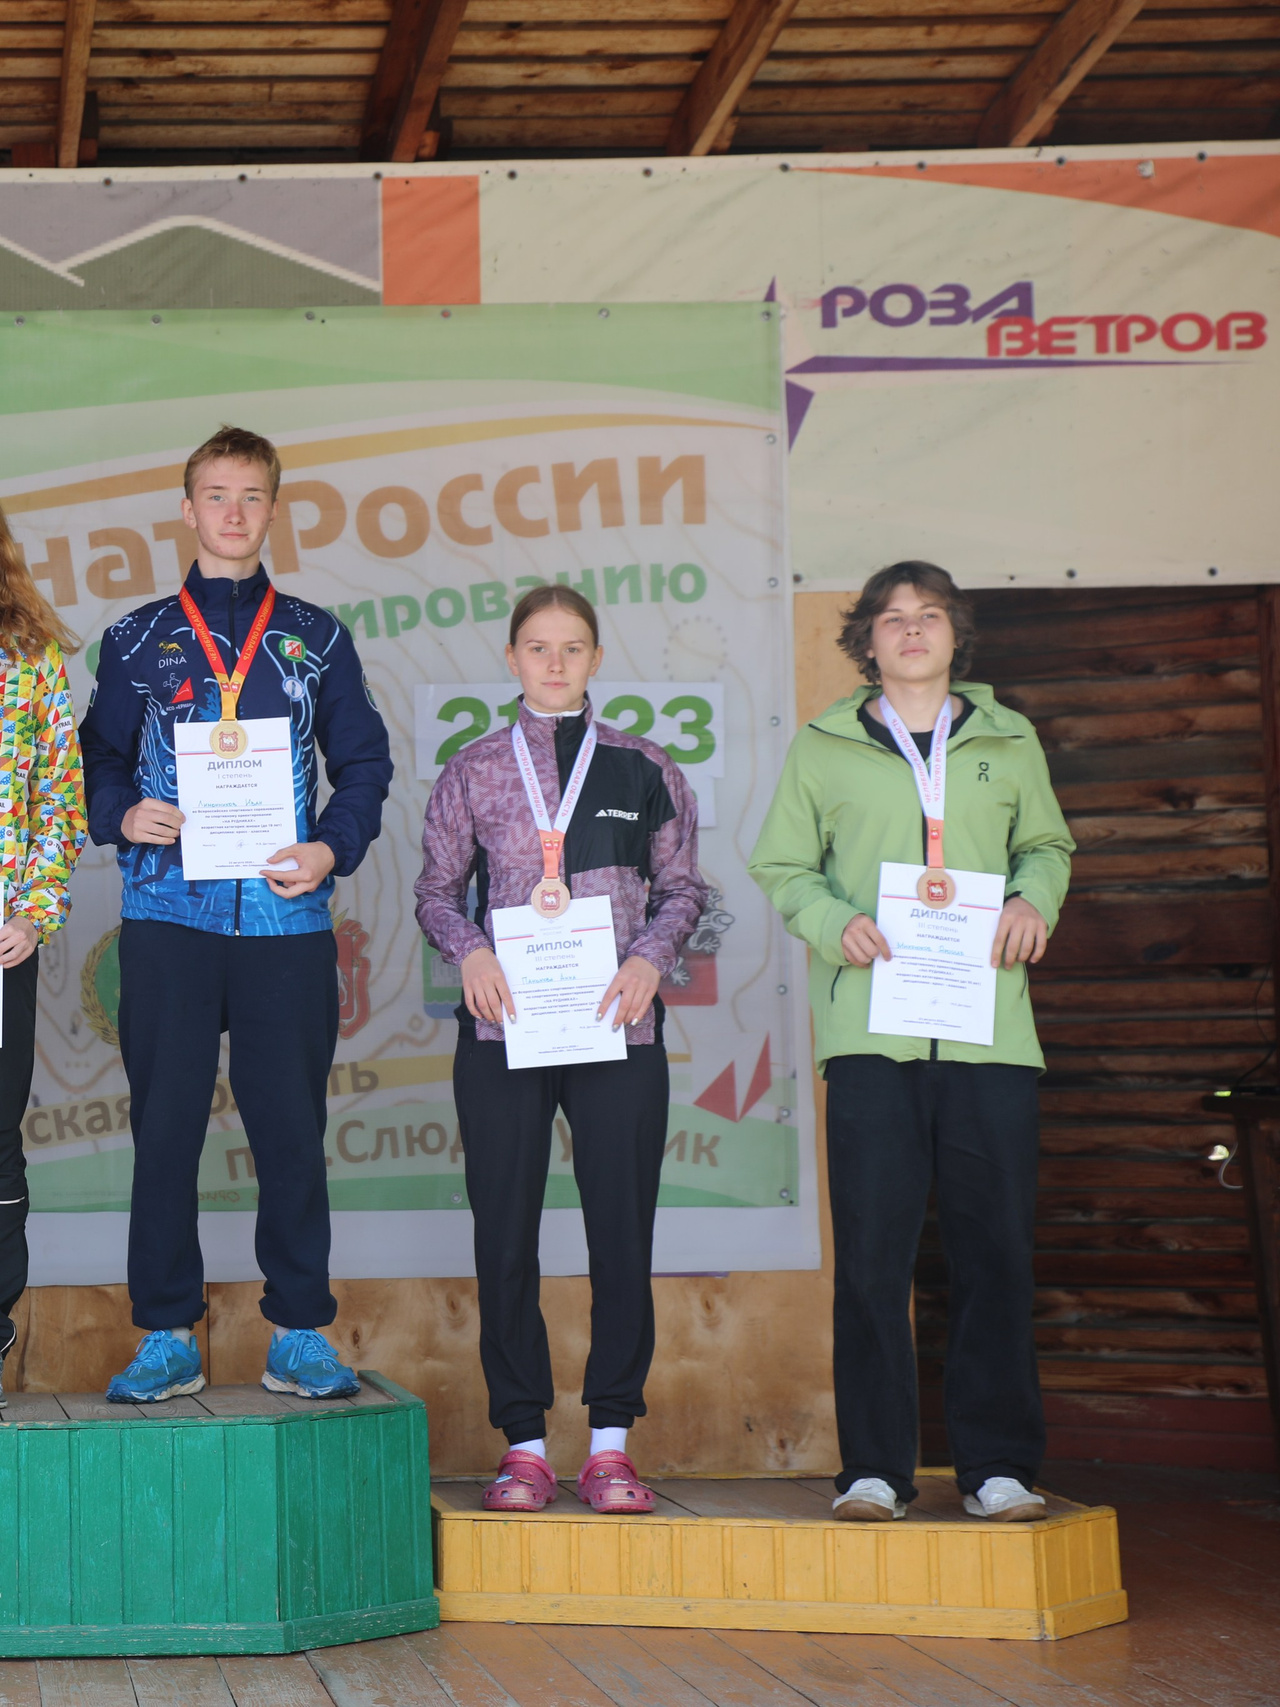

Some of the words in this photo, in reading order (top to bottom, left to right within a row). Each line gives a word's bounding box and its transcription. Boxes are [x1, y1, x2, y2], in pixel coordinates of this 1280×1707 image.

[820, 281, 1033, 328] РОЗА
[987, 312, 1267, 357] ВЕТРОВ
[267, 454, 707, 575] России
[158, 656, 187, 669] DINA
[207, 759, 262, 771] ДИПЛОМ
[605, 809, 639, 821] TERREX
[910, 908, 968, 924] ДИПЛОМ
[526, 939, 583, 954] ДИПЛОМ
